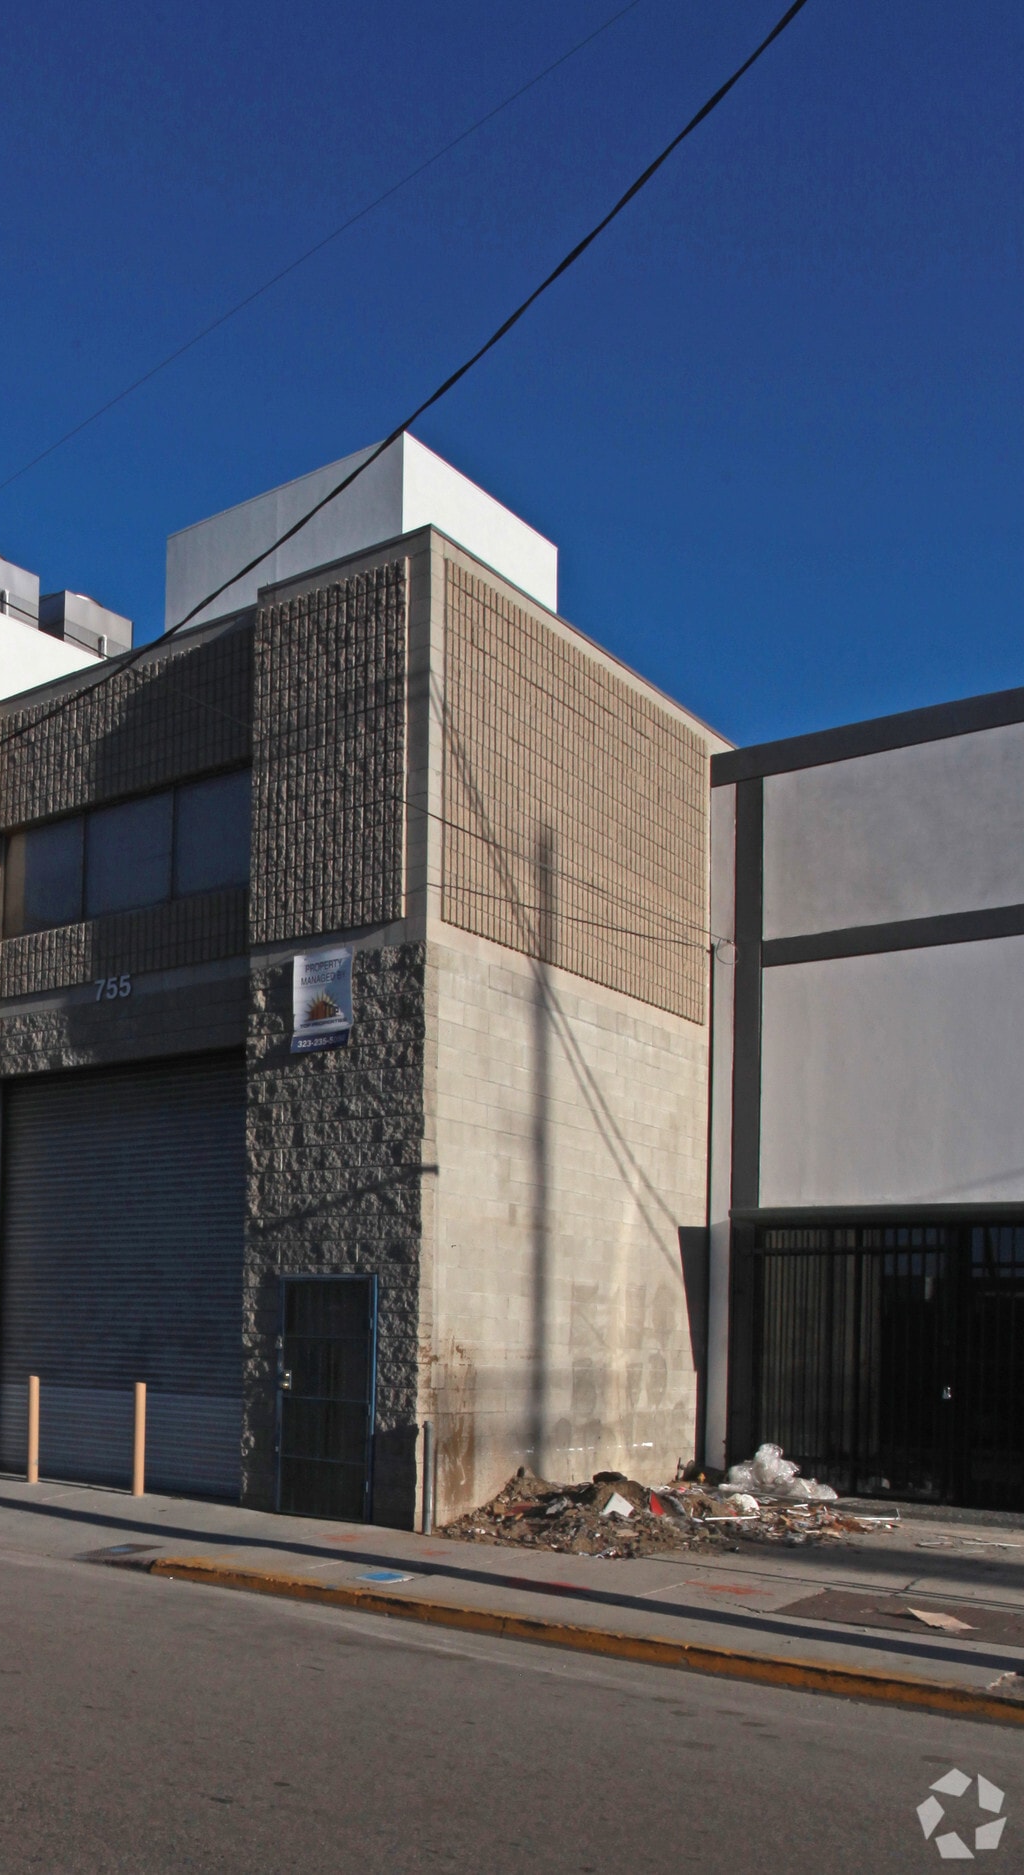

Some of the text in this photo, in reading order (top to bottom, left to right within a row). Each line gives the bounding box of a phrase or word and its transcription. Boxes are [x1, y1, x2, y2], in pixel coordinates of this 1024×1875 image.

[305, 959, 343, 973] PROPERTY
[300, 973, 335, 986] MANAGED
[94, 975, 131, 1001] 755
